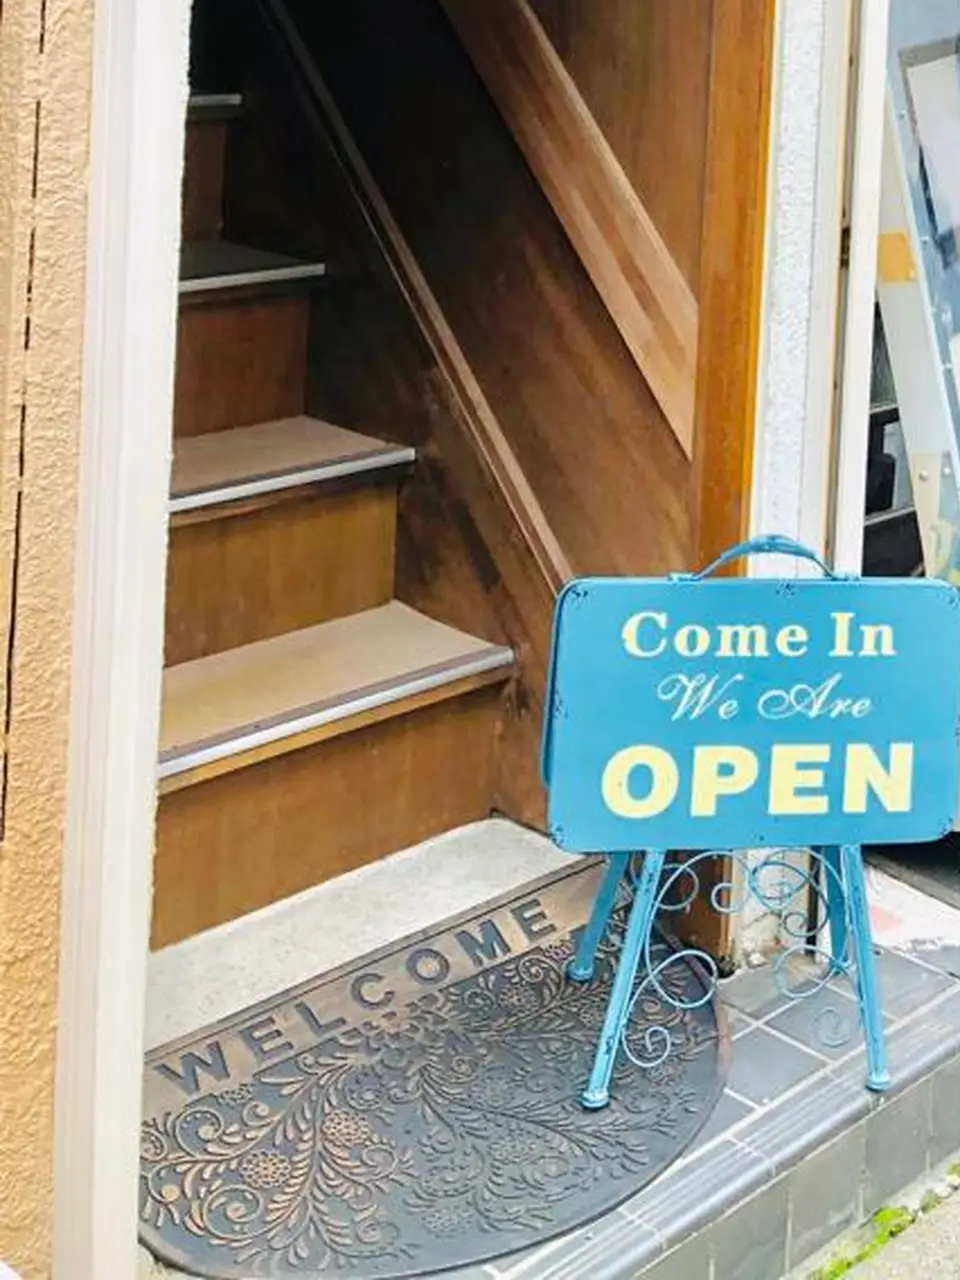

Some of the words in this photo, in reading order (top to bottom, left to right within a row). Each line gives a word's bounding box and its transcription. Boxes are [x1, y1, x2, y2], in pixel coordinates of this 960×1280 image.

[620, 609, 810, 659] Come
[827, 610, 898, 658] In
[656, 671, 743, 723] We
[757, 673, 877, 720] Are
[600, 741, 915, 820] OPEN
[154, 898, 559, 1100] WELCOME
